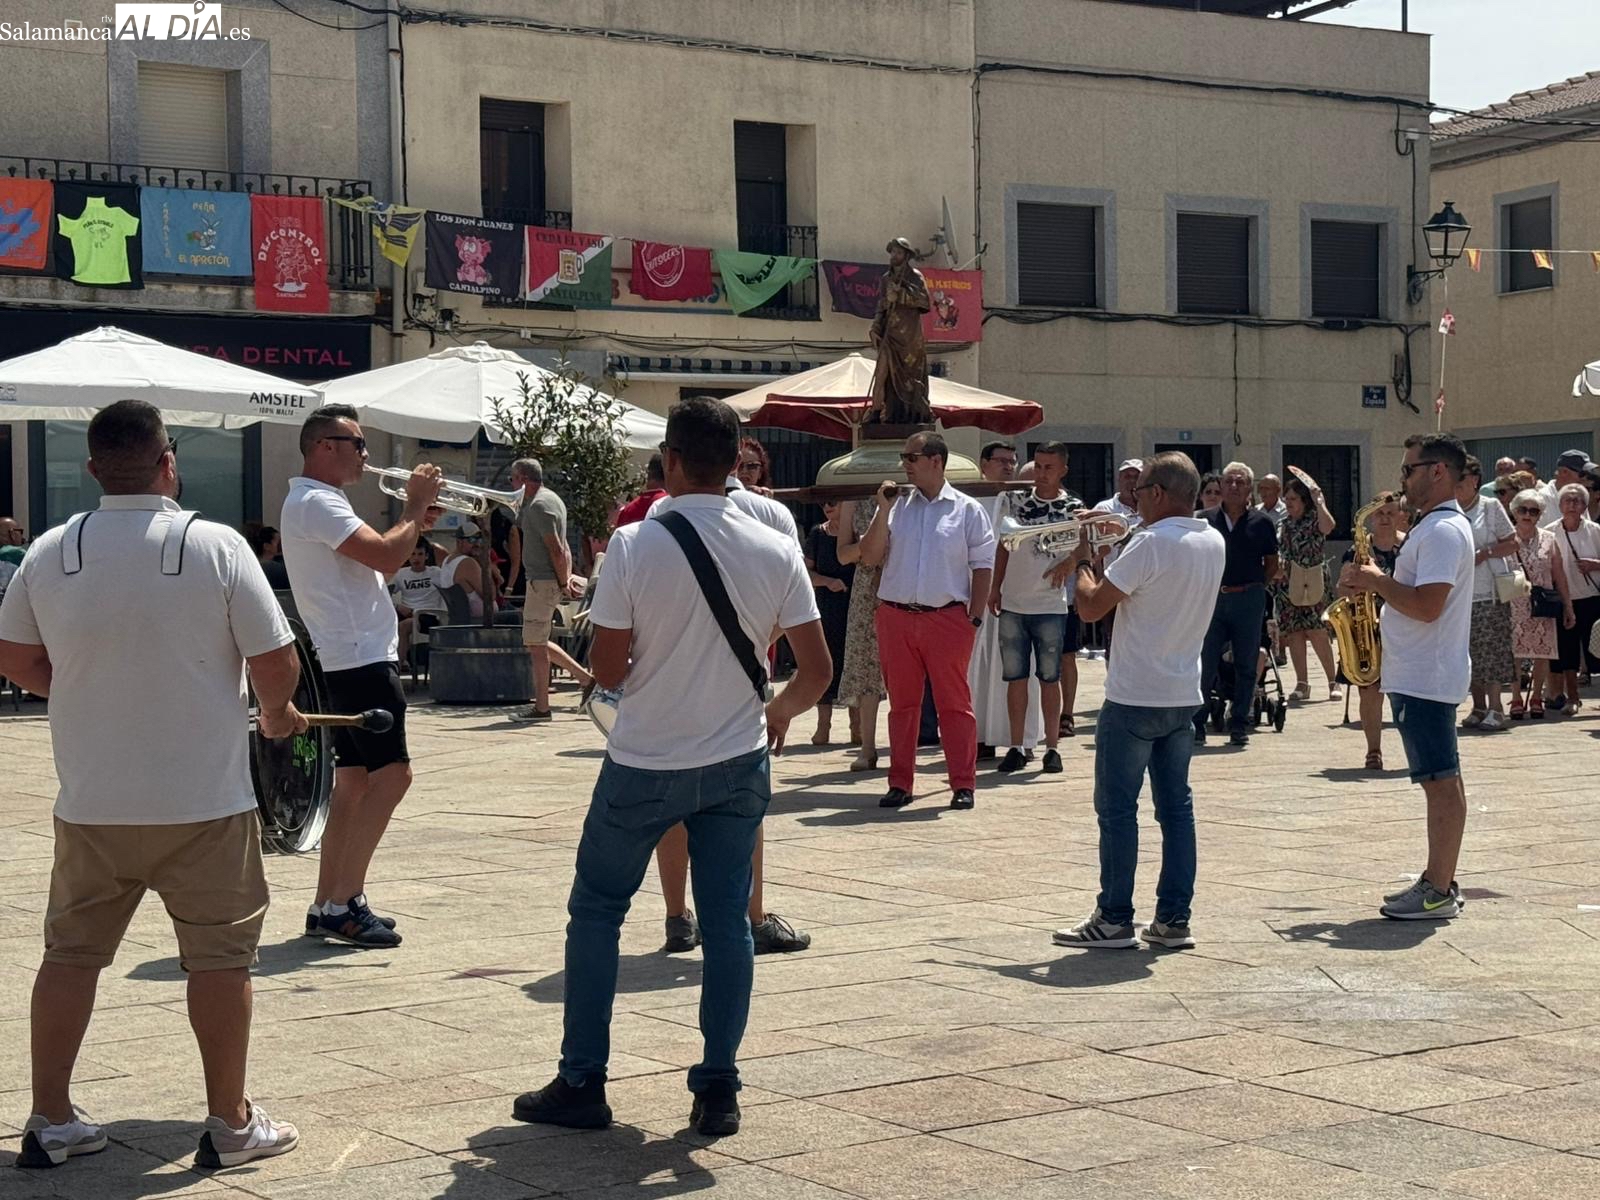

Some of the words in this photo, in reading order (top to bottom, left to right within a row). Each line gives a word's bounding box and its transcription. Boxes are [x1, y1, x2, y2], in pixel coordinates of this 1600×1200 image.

[435, 213, 454, 223] LOS
[455, 217, 476, 226] DON
[477, 220, 514, 231] JUANES
[258, 228, 323, 265] DESCONTROL
[449, 282, 501, 295] CANTALPINO
[243, 346, 352, 366] DENTAL
[248, 391, 306, 409] AMSTEL
[259, 407, 274, 415] 100%
[276, 408, 294, 417] MALTA
[403, 577, 432, 591] VANS
